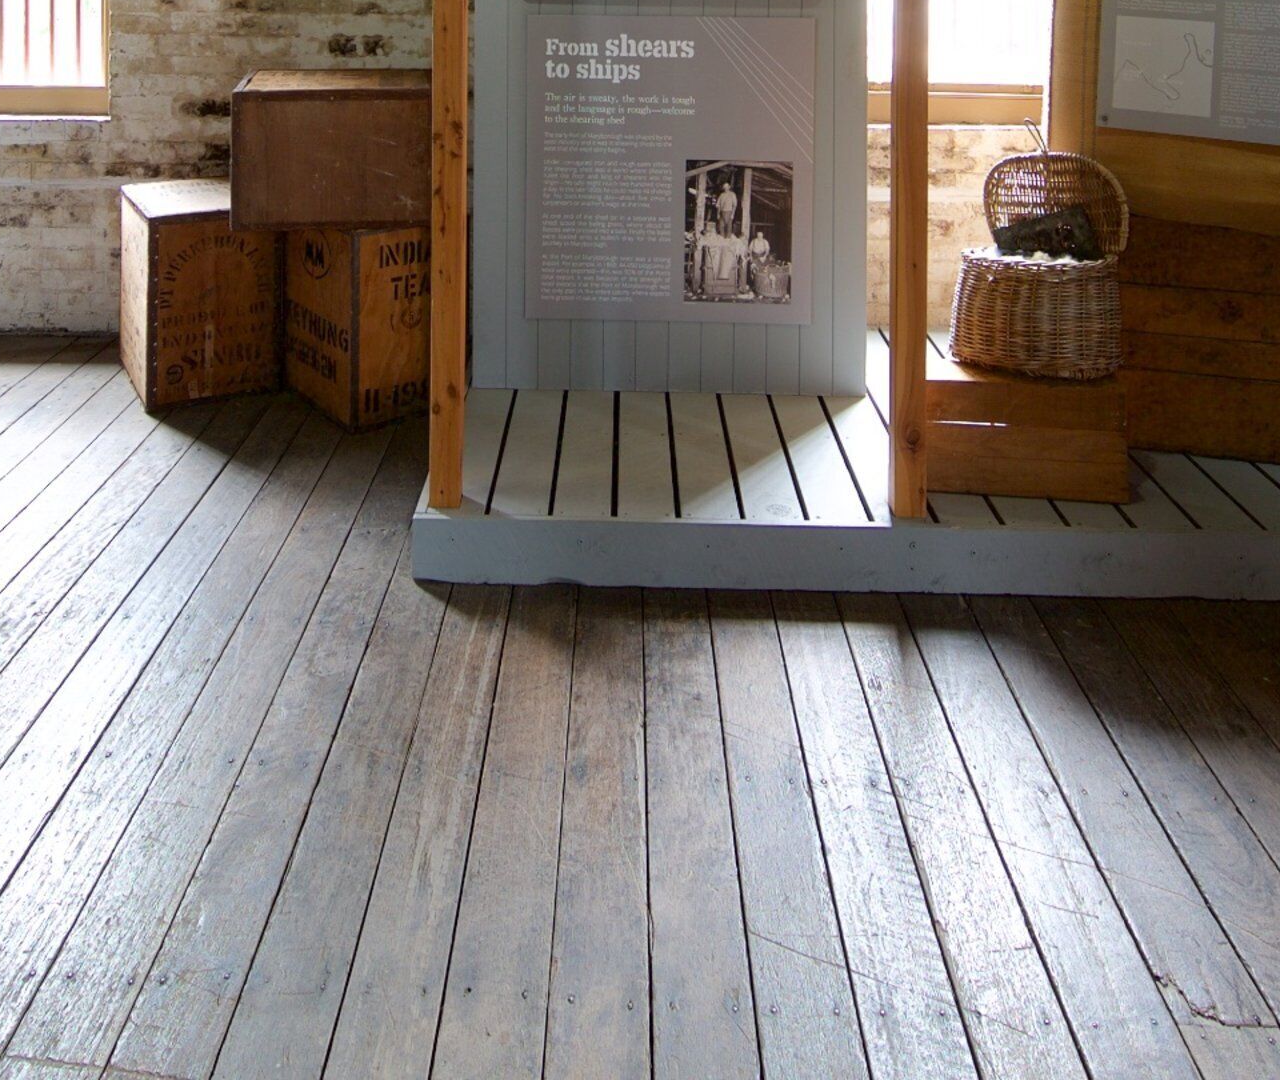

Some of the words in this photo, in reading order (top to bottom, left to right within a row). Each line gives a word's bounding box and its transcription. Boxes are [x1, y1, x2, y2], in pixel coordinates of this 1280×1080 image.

[545, 38, 599, 57] From
[605, 34, 696, 59] shears
[545, 60, 570, 80] to
[576, 59, 641, 83] ships
[544, 92, 561, 102] The
[563, 93, 576, 103] air
[579, 93, 586, 103] is
[622, 94, 636, 104] the
[639, 94, 659, 104] work
[662, 95, 669, 104] is
[672, 95, 696, 106] tough
[544, 103, 561, 113] and
[563, 104, 576, 113] the
[578, 104, 616, 115] language
[618, 106, 625, 114] is
[544, 115, 553, 123] to
[555, 115, 568, 123] the
[570, 115, 605, 126] shearing
[607, 116, 626, 125] shed
